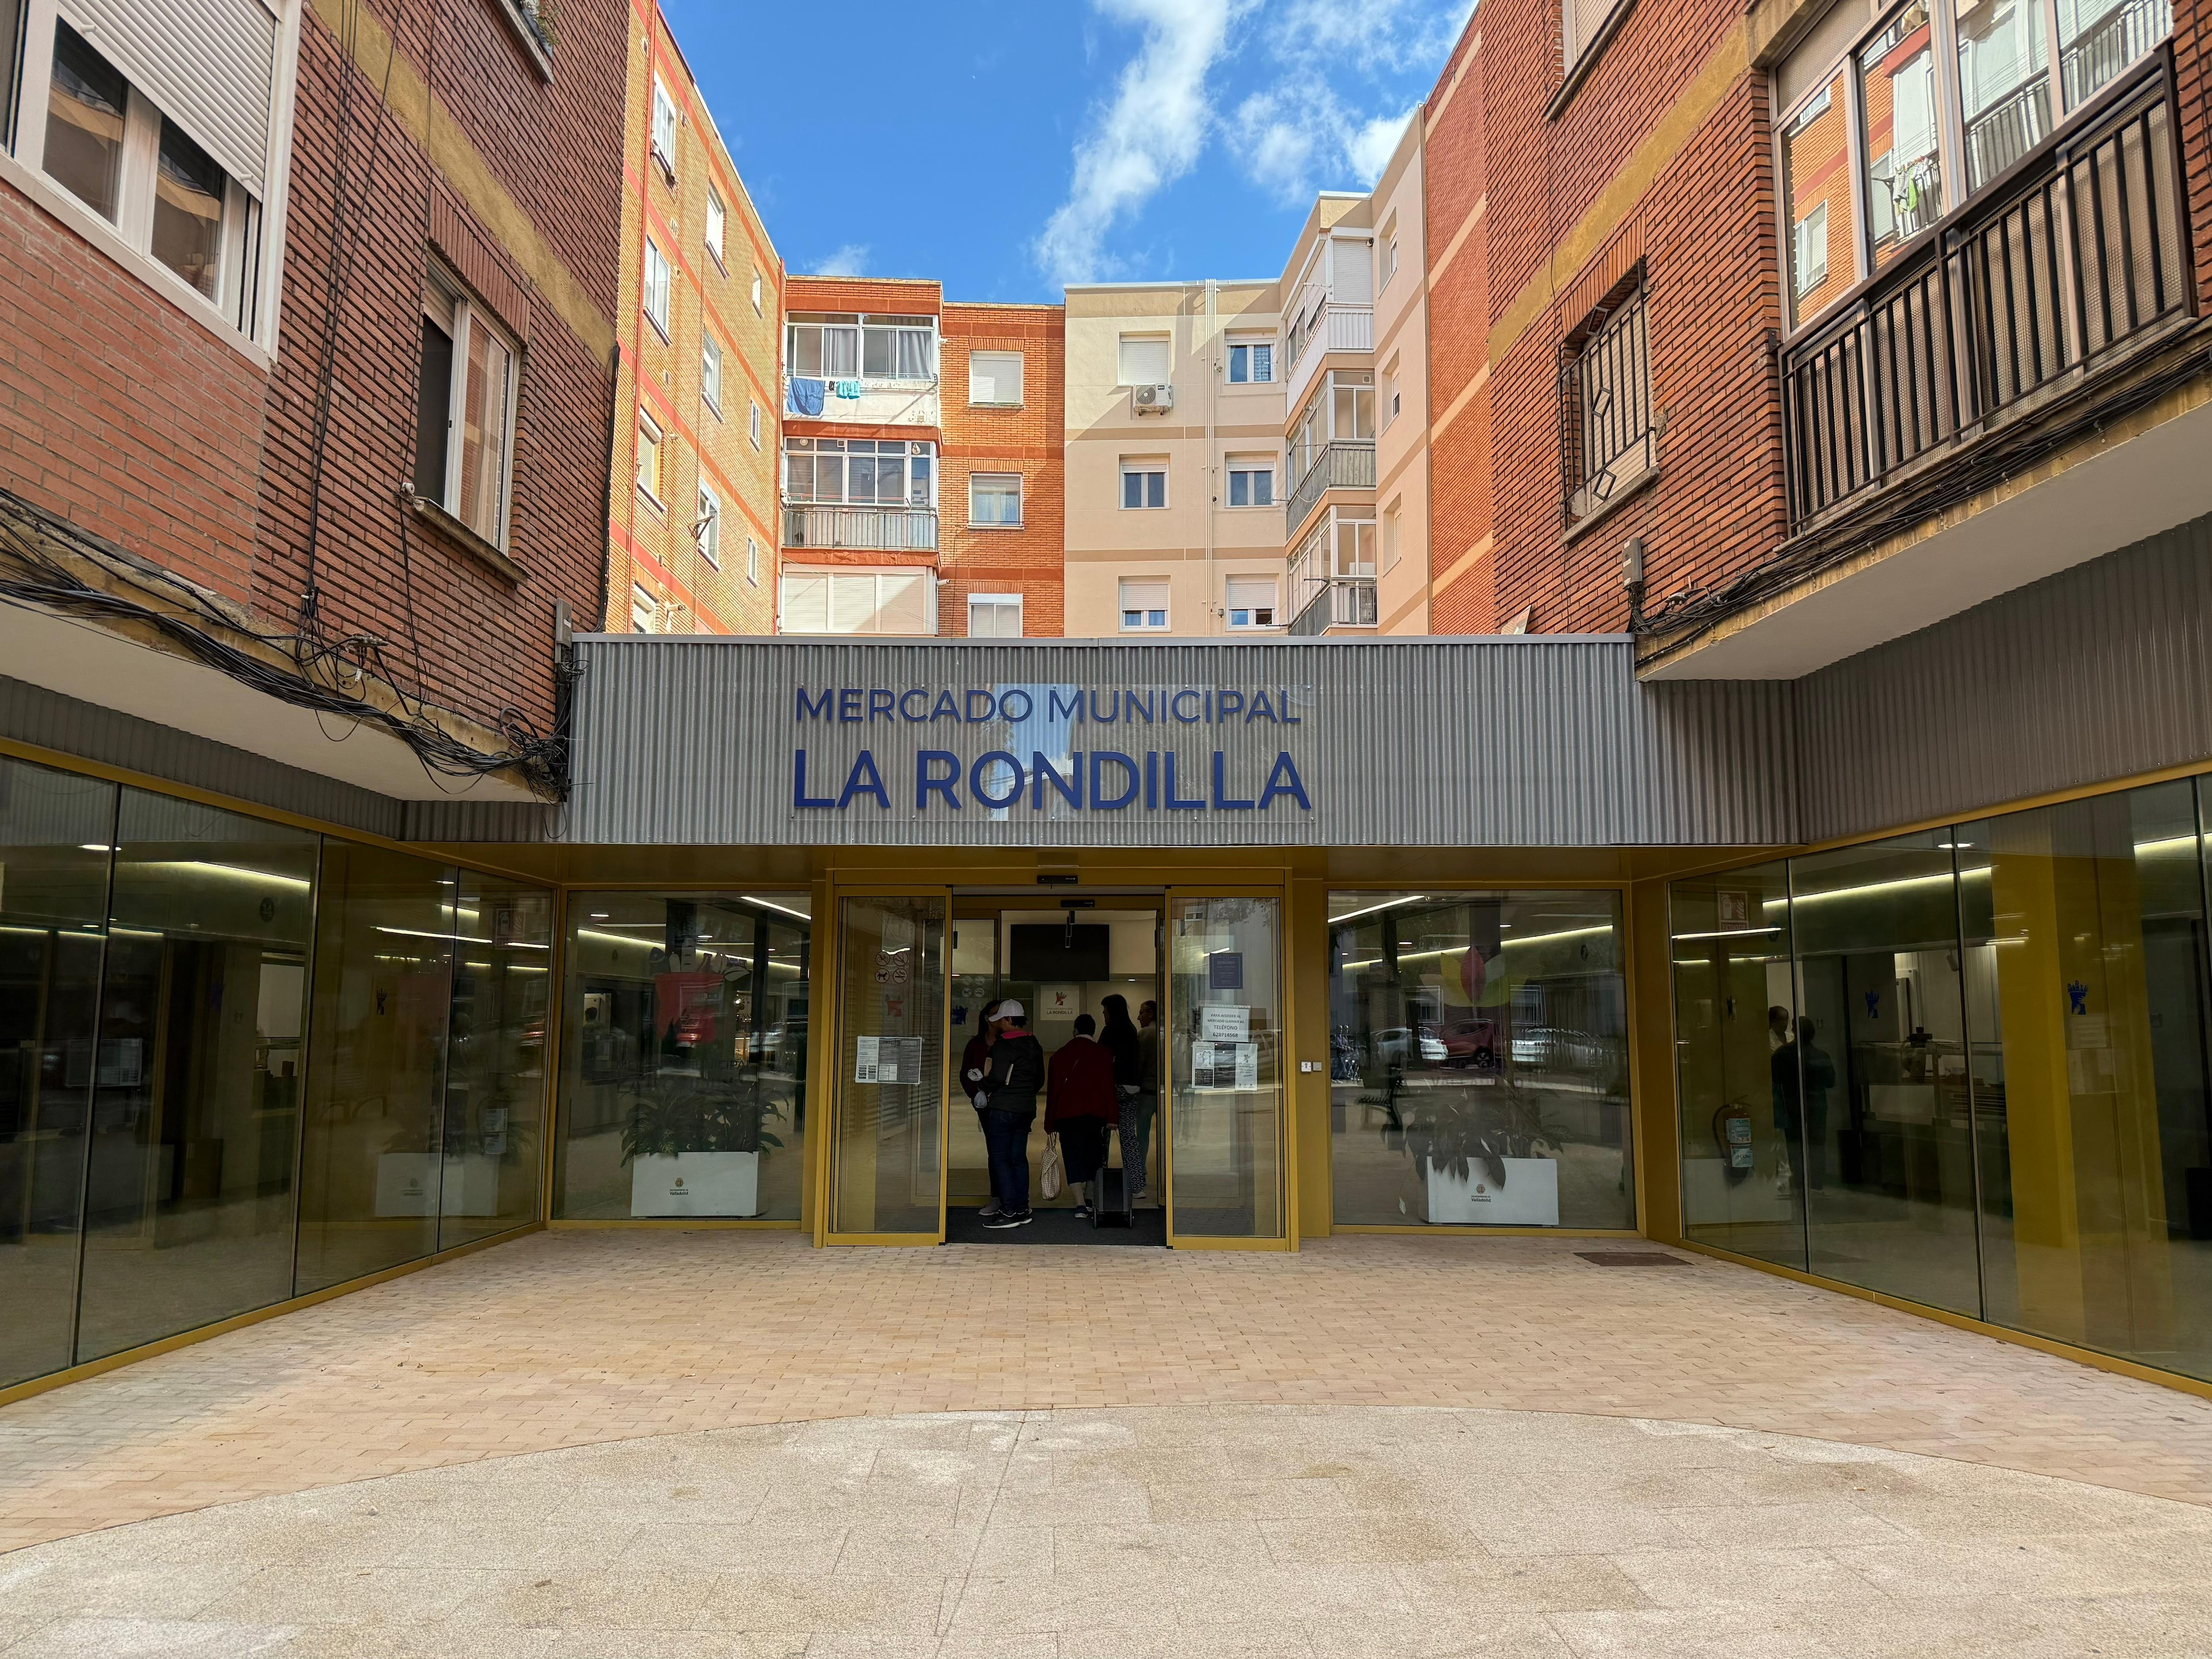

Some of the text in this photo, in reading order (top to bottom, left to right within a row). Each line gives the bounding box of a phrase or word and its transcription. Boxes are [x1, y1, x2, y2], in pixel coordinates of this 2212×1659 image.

[797, 689, 1301, 723] MERCADO MUNICIPAL
[795, 749, 1312, 810] LA RONDILLA
